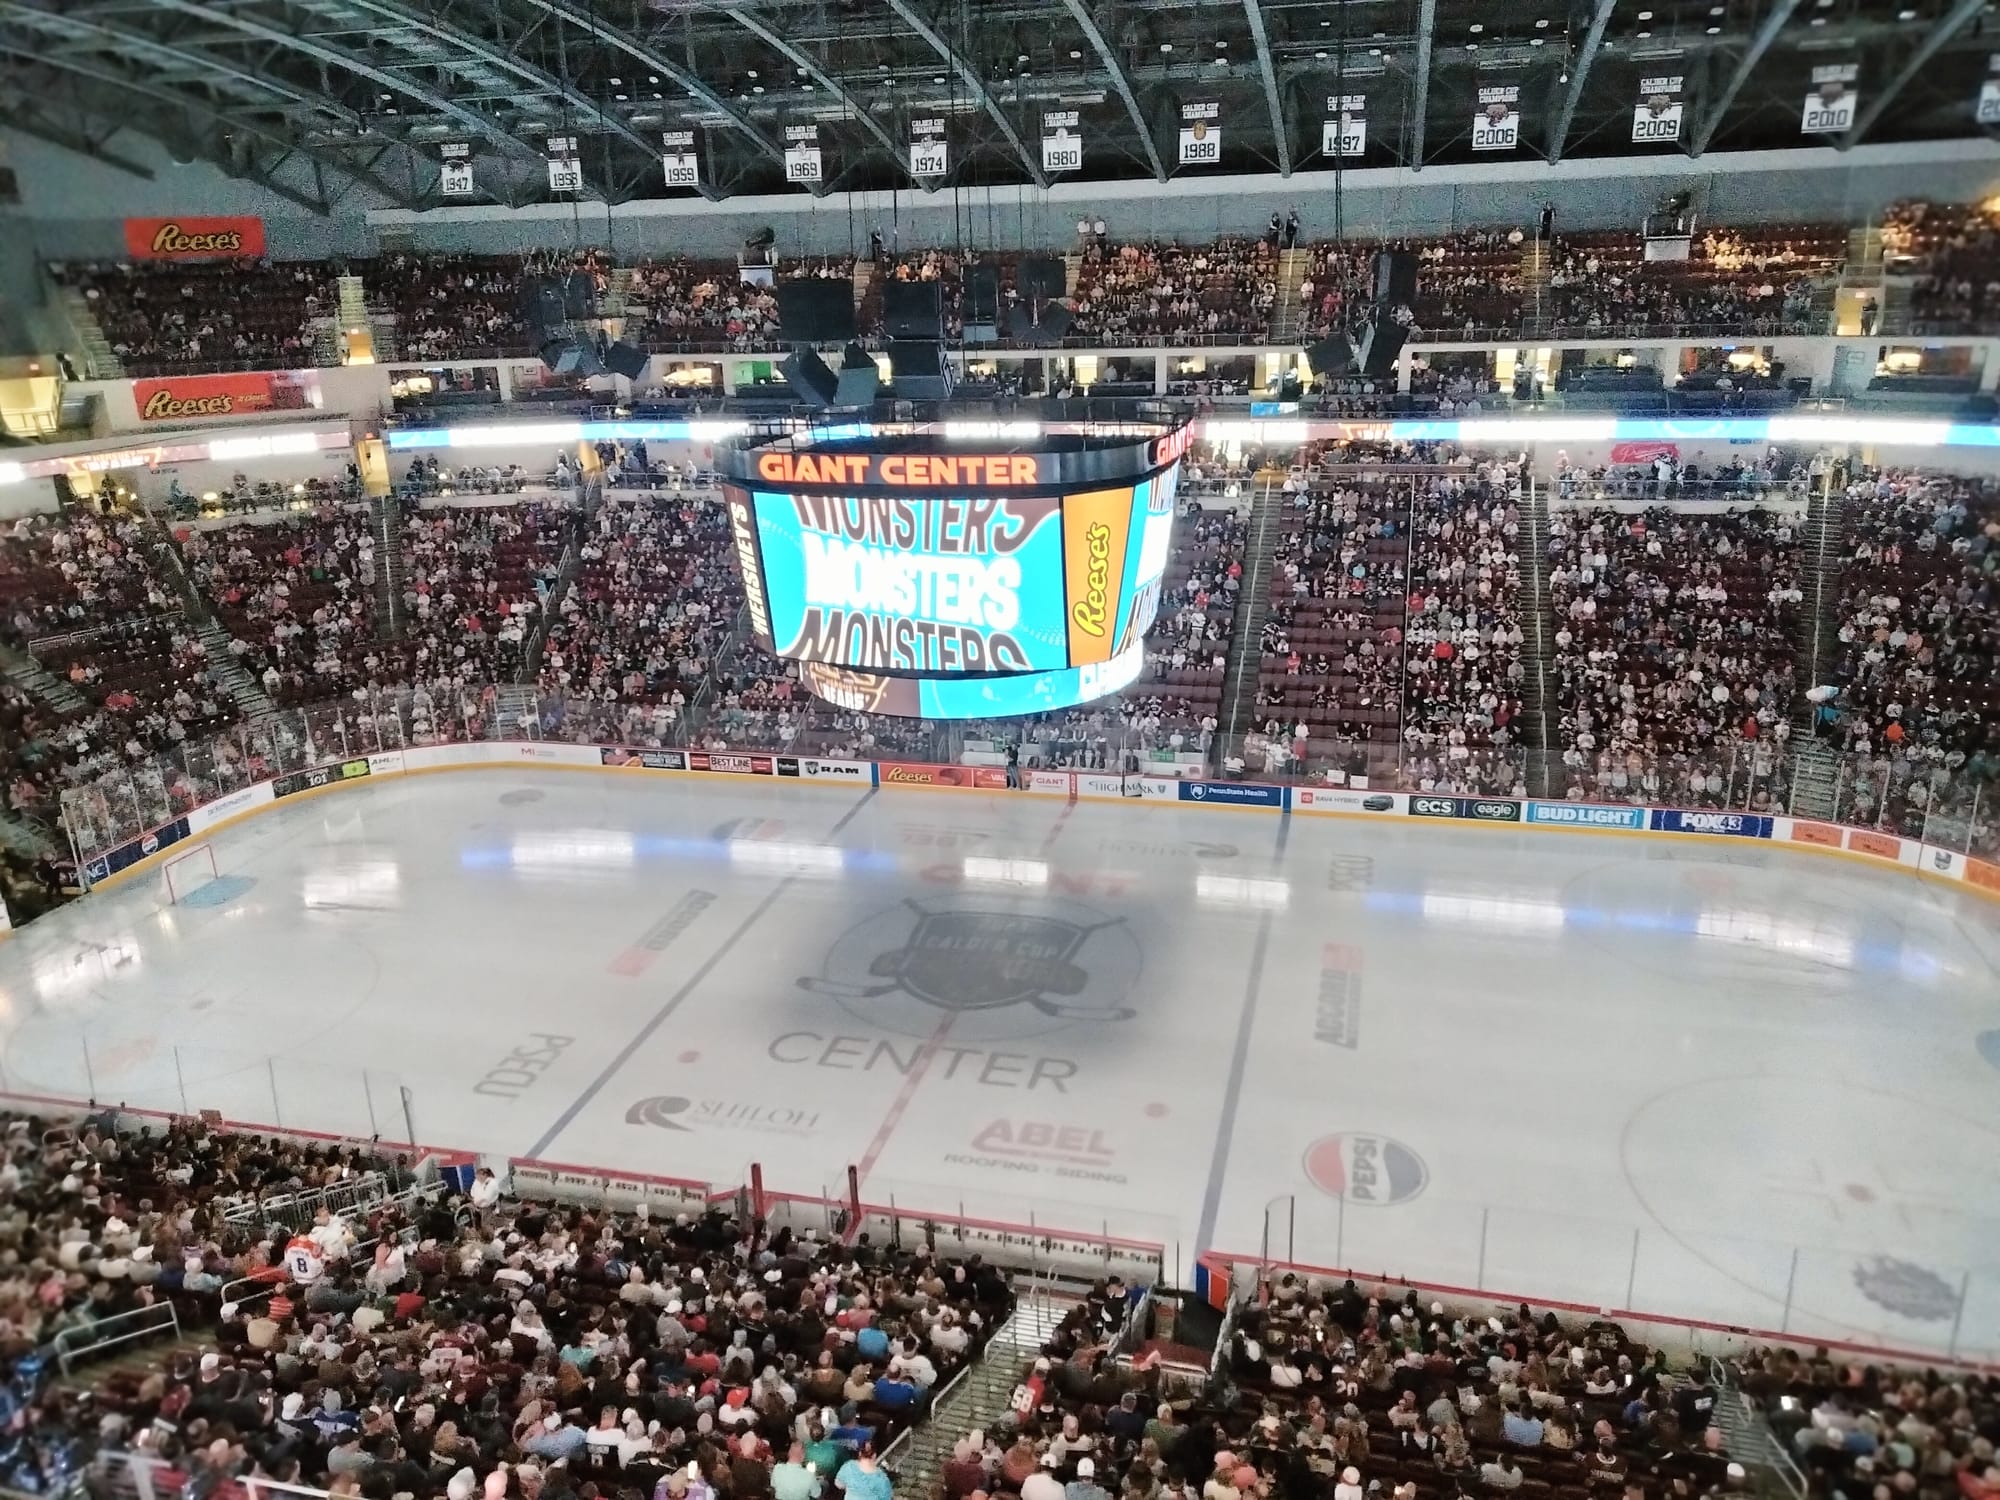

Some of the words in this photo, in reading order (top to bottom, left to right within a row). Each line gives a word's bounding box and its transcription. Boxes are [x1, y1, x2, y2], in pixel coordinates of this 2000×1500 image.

[1807, 109, 1849, 128] 2010
[1475, 129, 1514, 145] 2006
[1636, 120, 1678, 137] 2009
[1048, 151, 1078, 165] 1980
[1184, 143, 1216, 158] 1988
[790, 162, 818, 177] 1969
[914, 157, 942, 172] 1974
[667, 168, 694, 182] 1959
[152, 223, 241, 253] Reese's
[144, 389, 234, 420] Reese's
[758, 453, 870, 483] GIANT
[880, 455, 1039, 486] CENTER
[731, 501, 769, 636] HERSHEY'S
[801, 531, 1022, 631] MONSTERS
[1073, 521, 1111, 638] Reese's
[711, 757, 732, 766] BEST
[732, 757, 751, 768] LINE
[821, 766, 859, 775] RAM
[309, 773, 328, 787] 101
[1036, 777, 1065, 785] GIANT
[1244, 789, 1268, 797] Health
[1416, 800, 1452, 814] ecs
[1477, 804, 1512, 817] eagle
[1537, 807, 1577, 820] BUD
[1577, 809, 1633, 824] LIGHT
[472, 1033, 576, 1099] PSECU
[768, 1031, 1078, 1094] CENTER
[693, 1100, 821, 1129] SHILOH
[971, 1116, 1116, 1157] ABEL
[943, 1153, 1039, 1173] ROOFING
[1055, 1167, 1128, 1185] SIDING
[1352, 1137, 1377, 1201] PEPSI
[296, 1257, 308, 1273] 8
